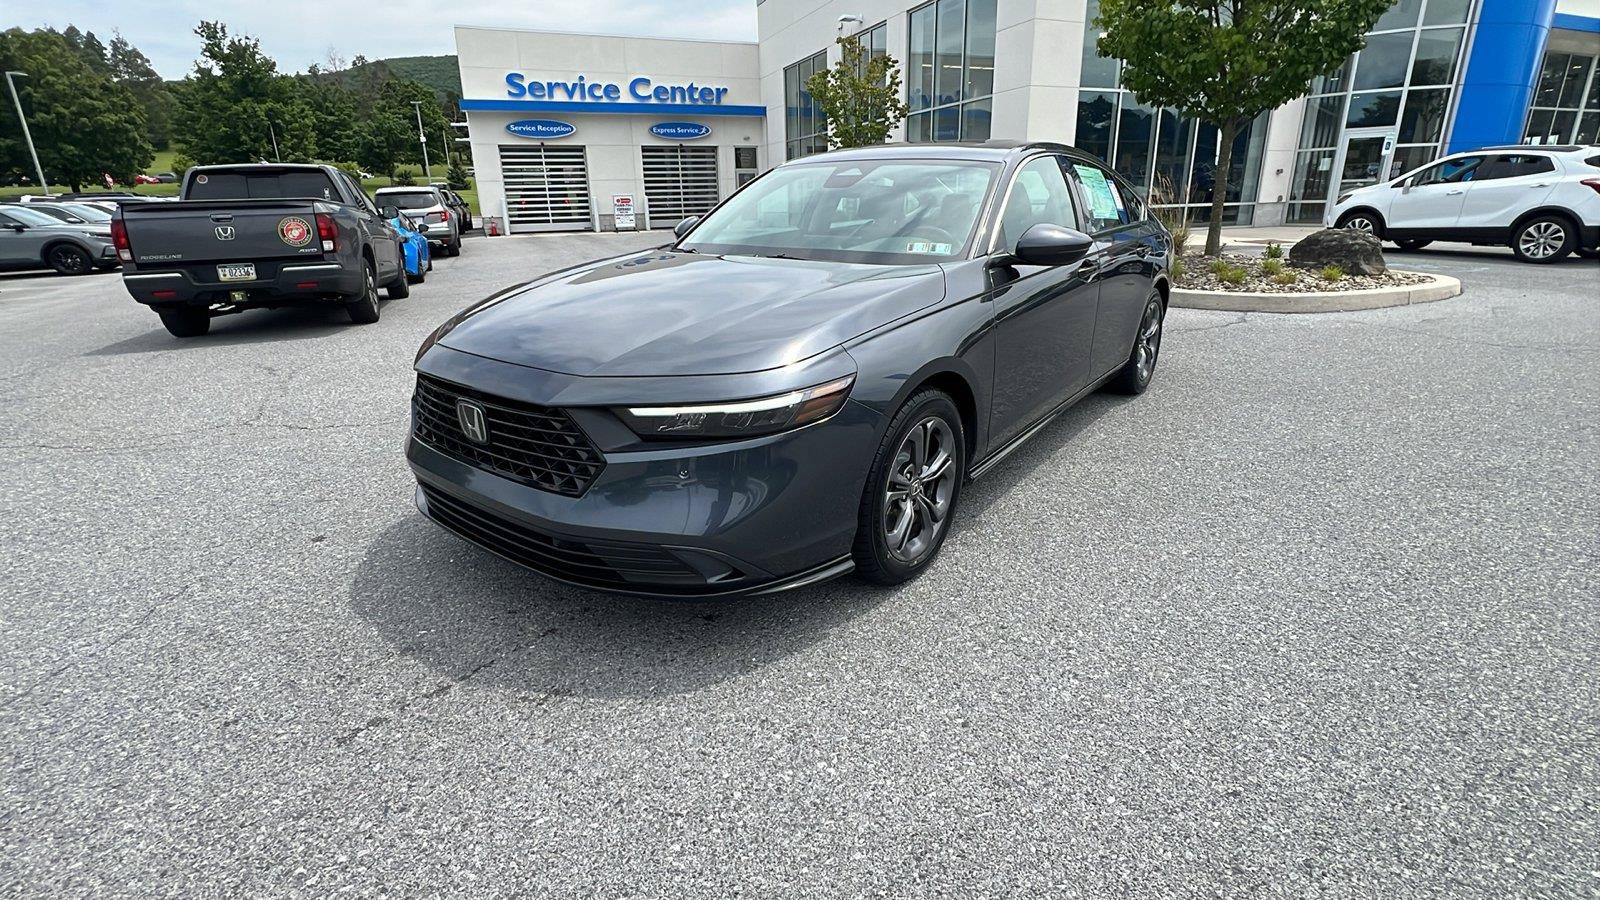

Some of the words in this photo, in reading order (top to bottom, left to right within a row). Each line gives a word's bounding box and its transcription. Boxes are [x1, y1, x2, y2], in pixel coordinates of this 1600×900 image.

[505, 72, 620, 101] Service
[628, 77, 729, 105] Center
[509, 124, 536, 132] Service
[537, 124, 573, 133] Reception
[652, 126, 676, 134] Express
